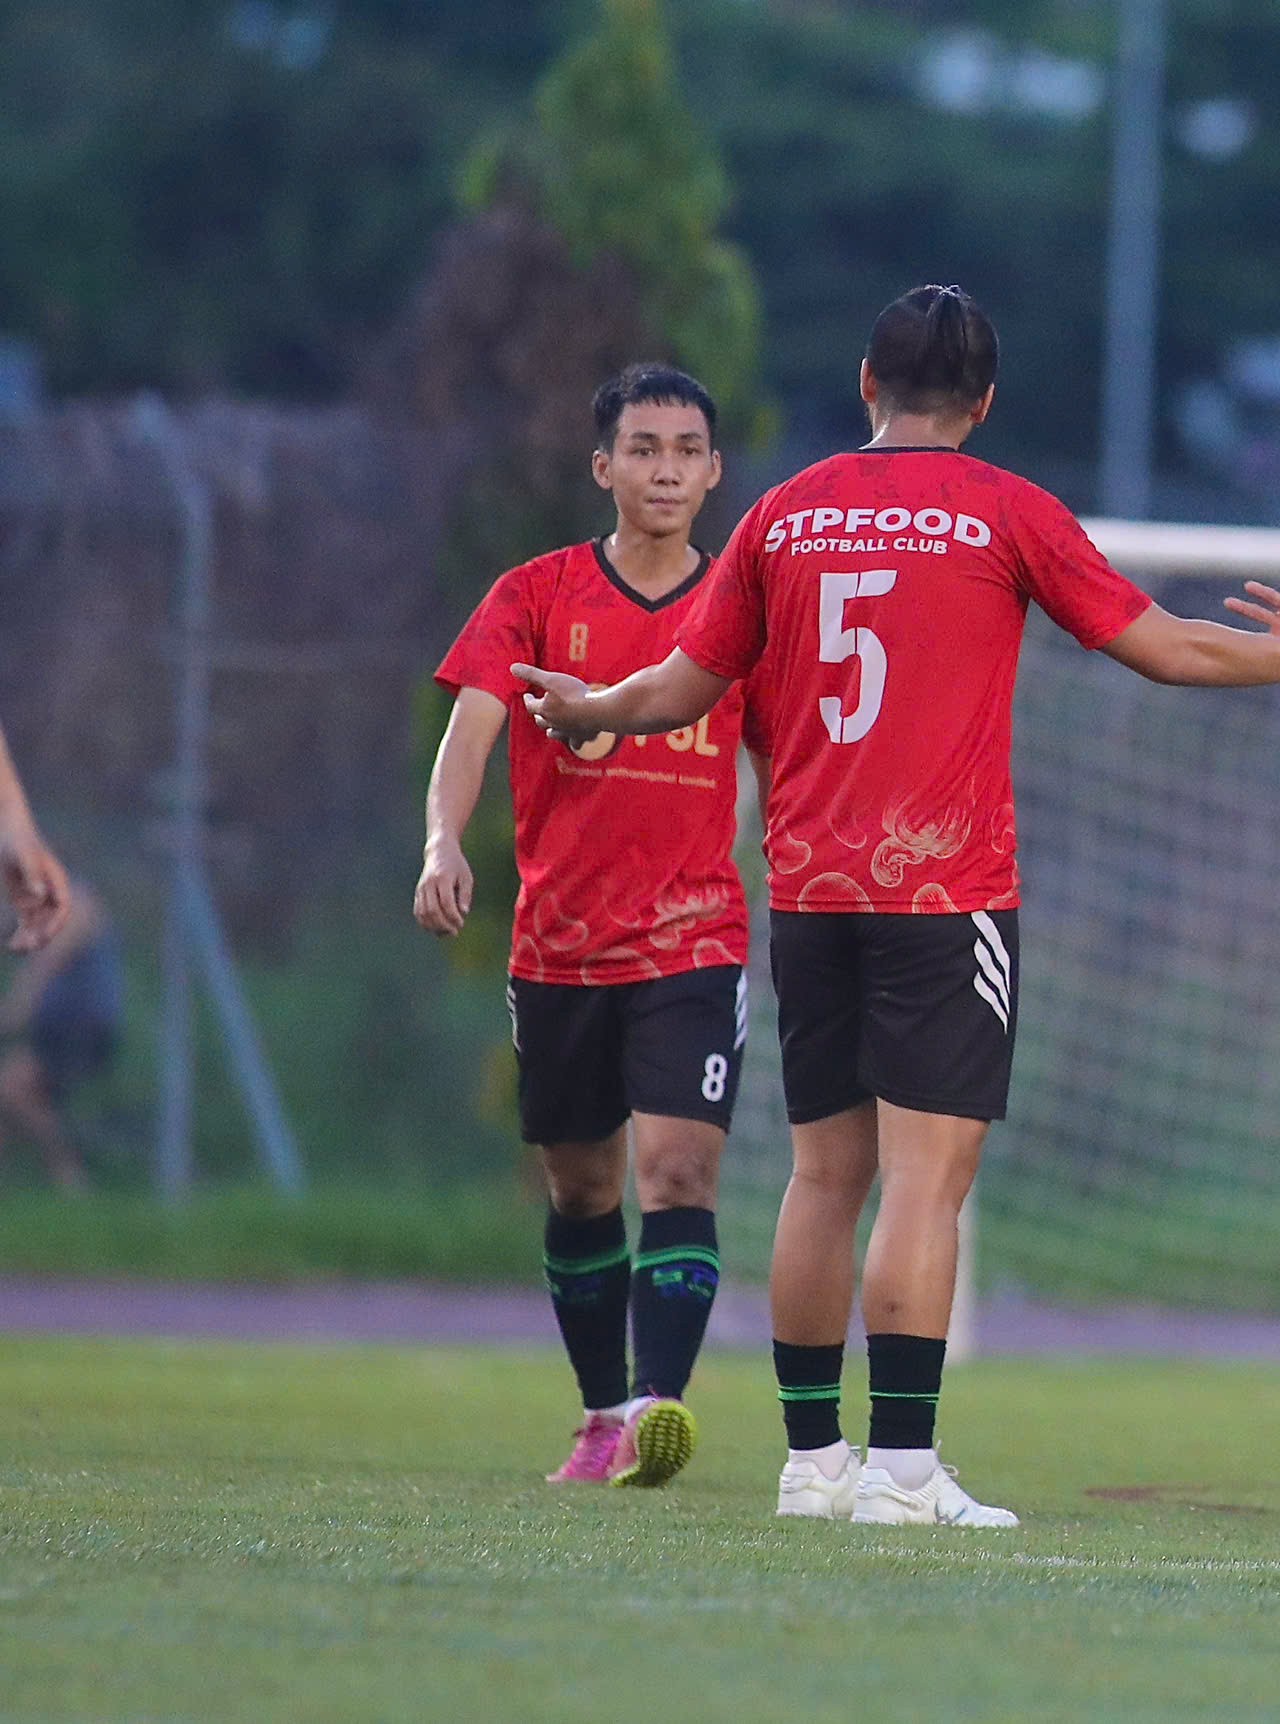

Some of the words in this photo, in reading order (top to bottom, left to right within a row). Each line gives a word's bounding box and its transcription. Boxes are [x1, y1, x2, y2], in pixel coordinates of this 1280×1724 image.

[765, 507, 992, 553] STPFOOD
[791, 537, 888, 556] FOOTBALL
[892, 537, 948, 555] CLUB
[568, 623, 589, 662] 8
[818, 569, 898, 744] 5
[701, 1053, 728, 1102] 8
